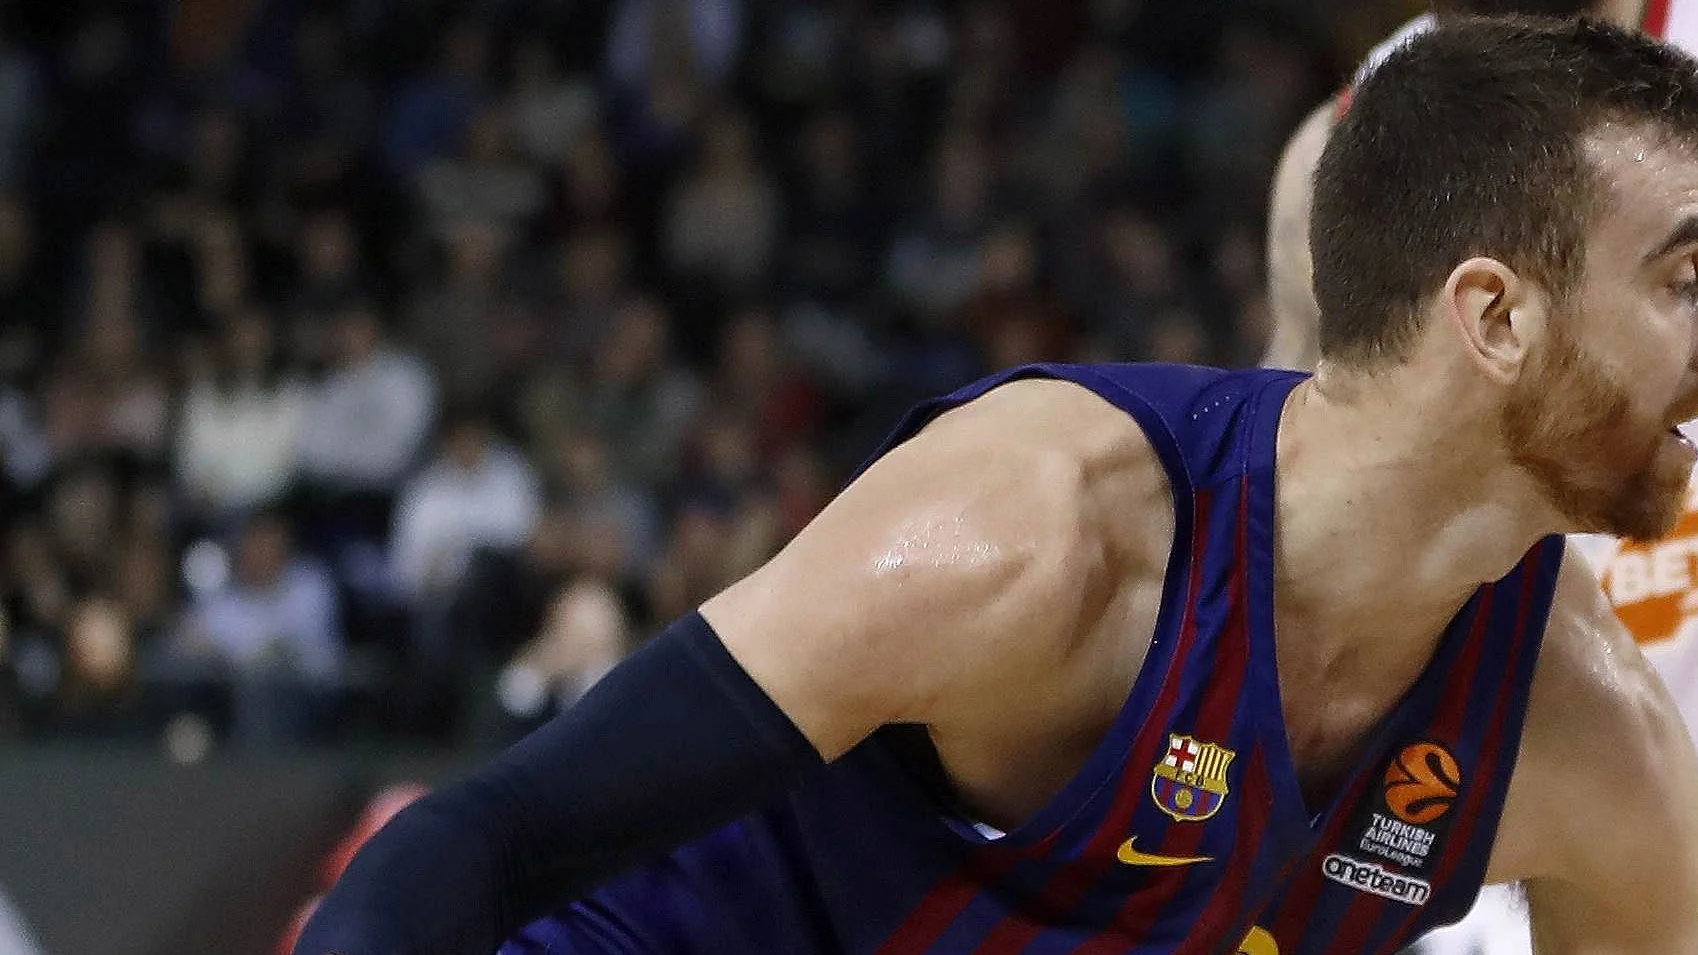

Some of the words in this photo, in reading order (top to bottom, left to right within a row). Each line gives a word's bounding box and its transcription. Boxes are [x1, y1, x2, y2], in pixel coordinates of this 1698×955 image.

[1365, 826, 1432, 858] AIRLINES
[1373, 813, 1435, 845] TURKISH
[1325, 857, 1427, 901] oneteam
